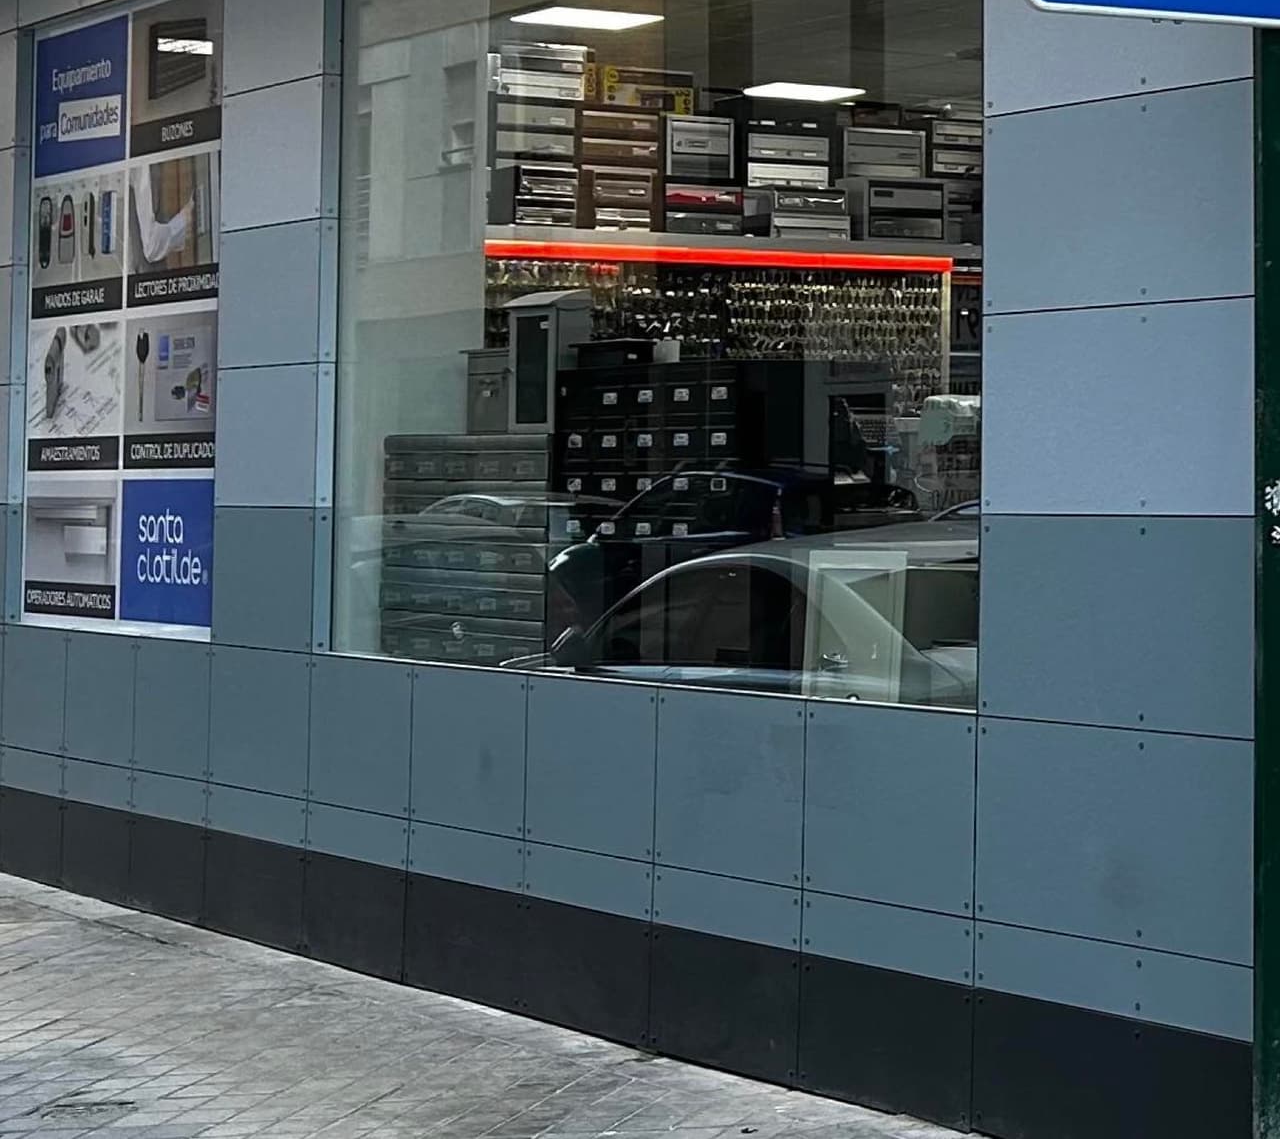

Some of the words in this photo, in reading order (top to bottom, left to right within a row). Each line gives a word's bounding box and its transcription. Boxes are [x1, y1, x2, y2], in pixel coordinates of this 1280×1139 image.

[52, 58, 111, 93] Equipamiento
[40, 122, 57, 145] para
[60, 102, 119, 135] Comunidades
[161, 120, 193, 142] BUZONES
[134, 278, 167, 298] LECTORES
[168, 277, 177, 295] DE
[130, 443, 163, 459] CONTROL
[163, 442, 173, 459] DE
[173, 442, 215, 459] DUPLICADO
[138, 508, 184, 544] santa
[137, 547, 201, 585] clotilde
